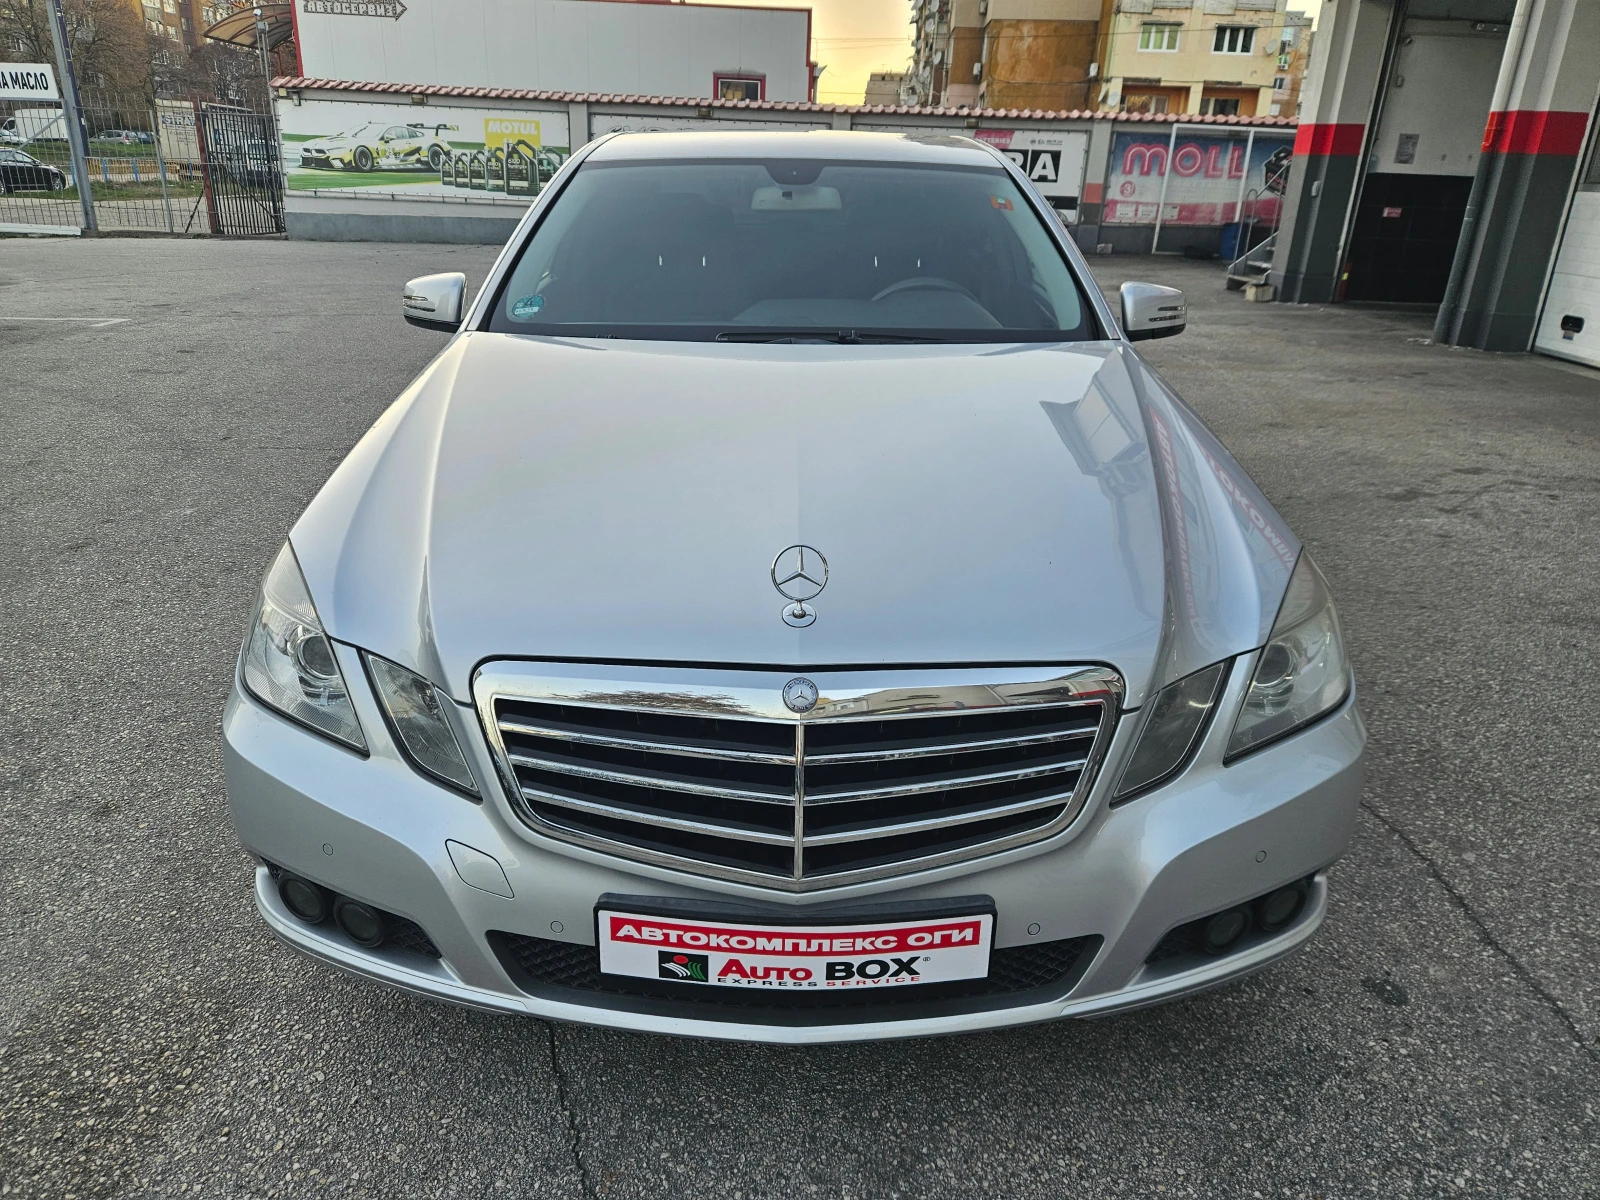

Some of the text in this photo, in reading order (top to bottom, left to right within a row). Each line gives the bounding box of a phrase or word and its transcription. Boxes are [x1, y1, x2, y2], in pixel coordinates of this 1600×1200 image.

[307, 1, 394, 16] АВТОСЕРВИЗ
[9, 71, 49, 91] МАСЛО
[487, 121, 538, 135] MOTUL
[615, 924, 974, 952] АВТОКОМПЛЕКС ОГИ
[718, 975, 921, 987] EXPRESS SERVICE
